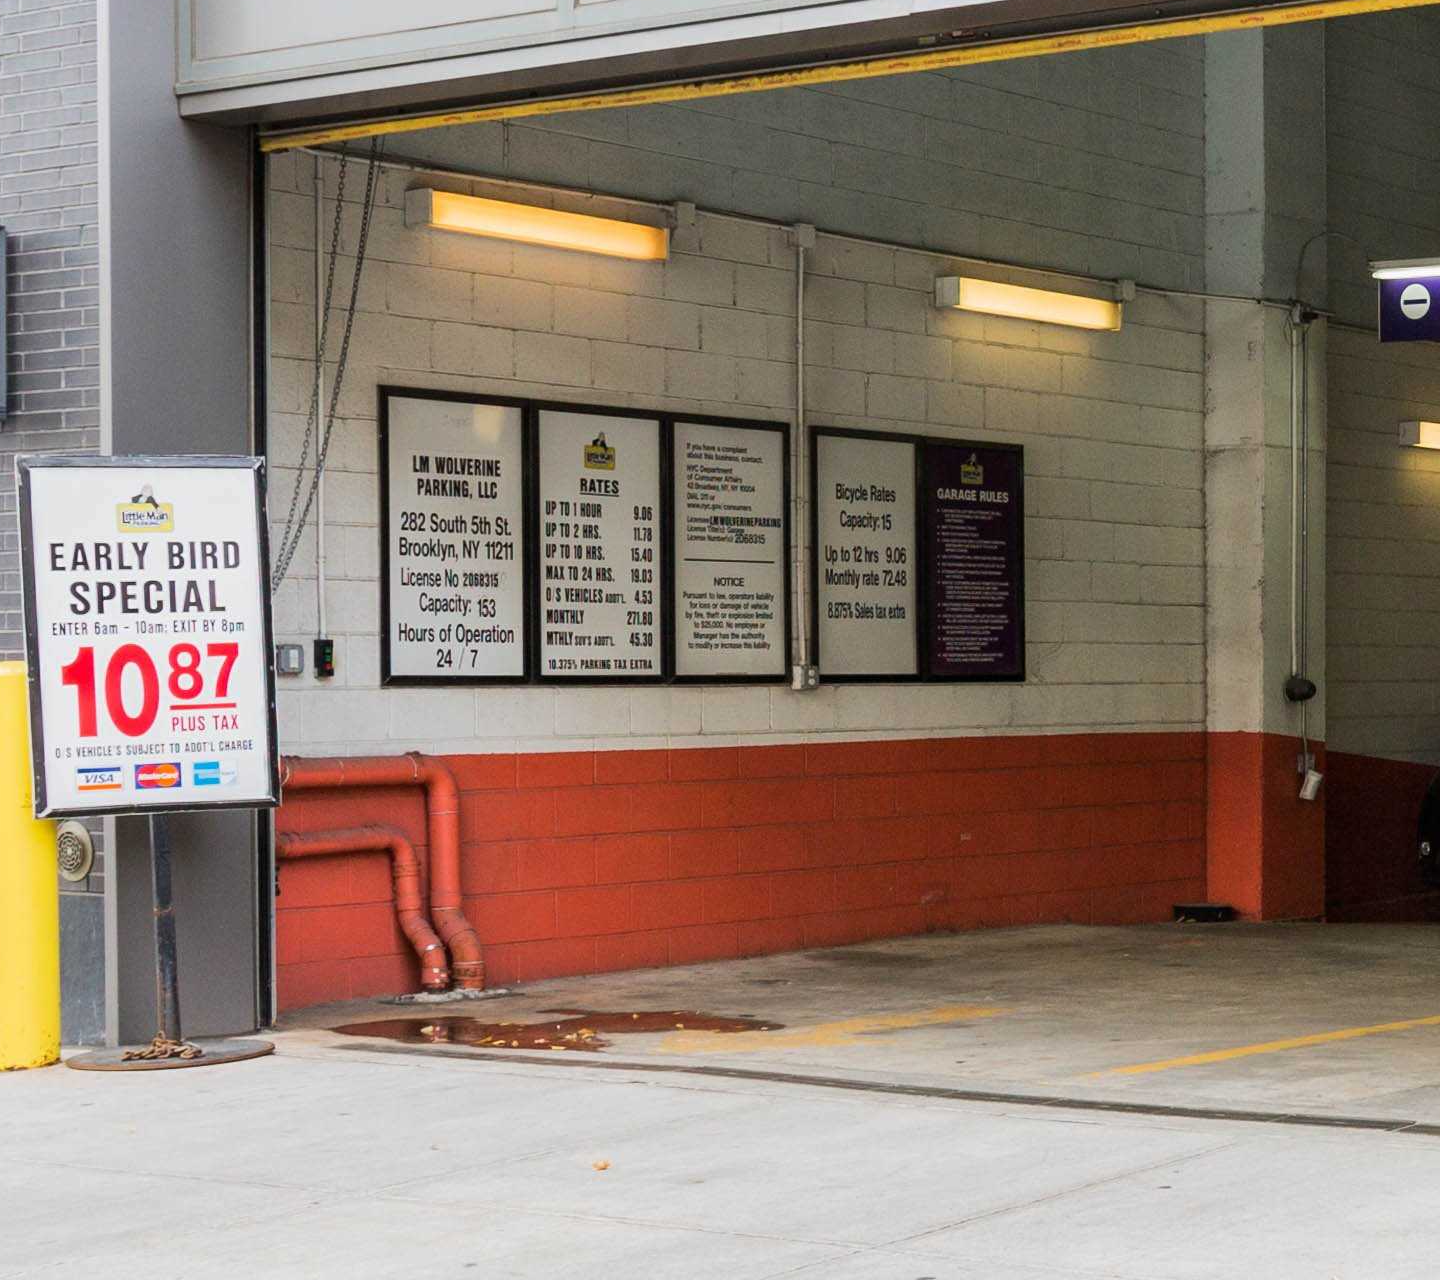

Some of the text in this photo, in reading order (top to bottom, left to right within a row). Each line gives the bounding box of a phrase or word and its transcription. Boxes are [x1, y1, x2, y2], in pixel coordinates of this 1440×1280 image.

[412, 455, 501, 477] LM WOLVERINE
[417, 478, 498, 499] PARKING, LLC
[580, 478, 619, 494] RATES
[836, 483, 896, 504] Bicycle Rates
[937, 488, 1009, 503] GARAGE RULES
[546, 501, 653, 521] UP TO 1 HOUR 9.06
[400, 511, 511, 536] 282 South 5th St.
[546, 522, 556, 537] UP
[560, 523, 570, 538] TO
[574, 524, 579, 538] 2
[583, 525, 601, 539] HRS.
[840, 510, 892, 532] Capacity: 15
[50, 541, 240, 571] EARLY BIRD
[399, 537, 514, 562] Brooklyn, NY 11211
[546, 544, 653, 562] UP TO 10 HRS. 15.40
[825, 544, 906, 565] Up to 12 hrs 9.06
[401, 568, 498, 588] License No 2068315
[546, 565, 653, 583] MAX TO 24 HRS. 19.03
[714, 577, 744, 587] NOTICE
[825, 568, 907, 589] Monthly rate 72.48
[70, 580, 226, 615] SPECIAL
[419, 592, 496, 617] Capacity: 153
[565, 588, 603, 603] VEHICLES
[635, 590, 653, 604] 4.53
[546, 609, 584, 624] MONTHLY
[855, 602, 874, 619] Sales
[875, 603, 886, 619] tax
[888, 604, 905, 619] extra
[52, 623, 88, 636] ENTER
[94, 623, 119, 635] 6am
[173, 620, 197, 633] EXIT
[203, 620, 216, 632] BY
[221, 620, 245, 634] 8pm
[399, 623, 514, 647] Hours of Operation
[546, 631, 573, 646] MTHLY
[630, 632, 653, 647] 45.30
[436, 649, 453, 668] 24
[470, 649, 478, 667] 7
[580, 659, 611, 670] PARKING
[613, 660, 627, 669] TAX
[630, 659, 653, 669] EXTRA
[61, 642, 239, 737] 10 87
[172, 714, 239, 731] PLUS TAX
[76, 744, 122, 757] VEHICLE'S
[126, 743, 165, 756] SUBJECT
[169, 743, 180, 753] TO
[219, 739, 254, 751] CHARGE
[84, 774, 114, 784] VISA
